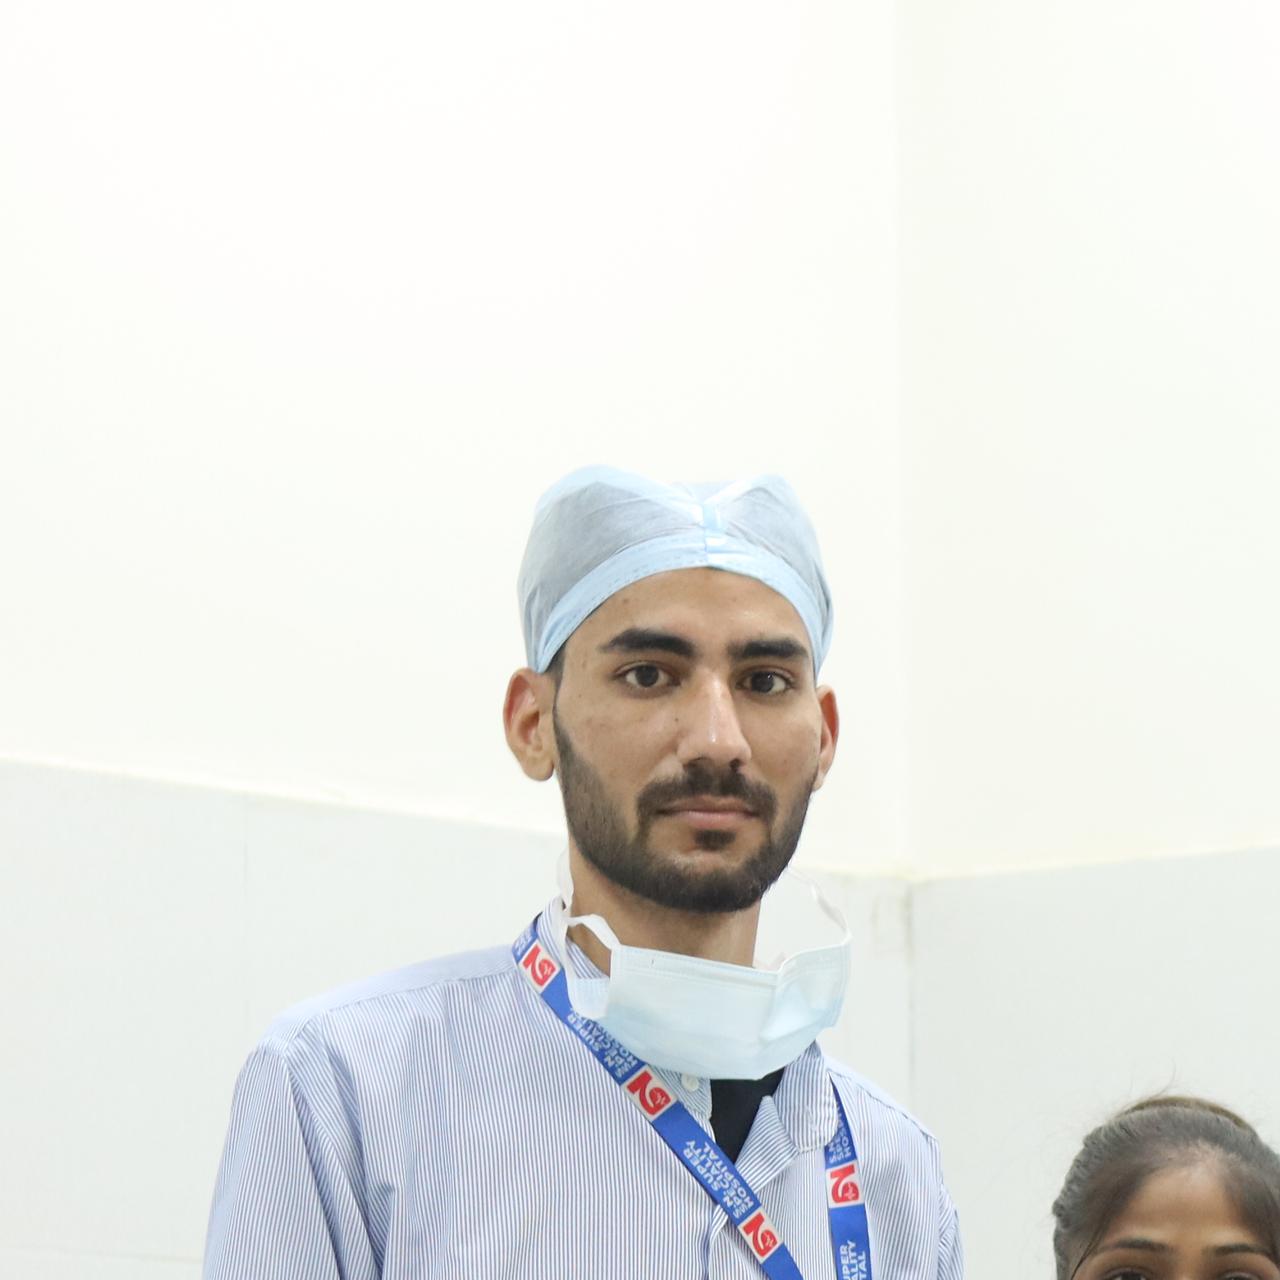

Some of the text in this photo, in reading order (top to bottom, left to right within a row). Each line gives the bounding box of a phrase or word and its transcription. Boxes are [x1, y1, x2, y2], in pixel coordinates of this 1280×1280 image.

[567, 1012, 602, 1052] SUPER
[683, 1147, 743, 1219] S.N. SUPER
[686, 1140, 750, 1214] SPECIALITY
[704, 1142, 755, 1208] HOSPITAL
